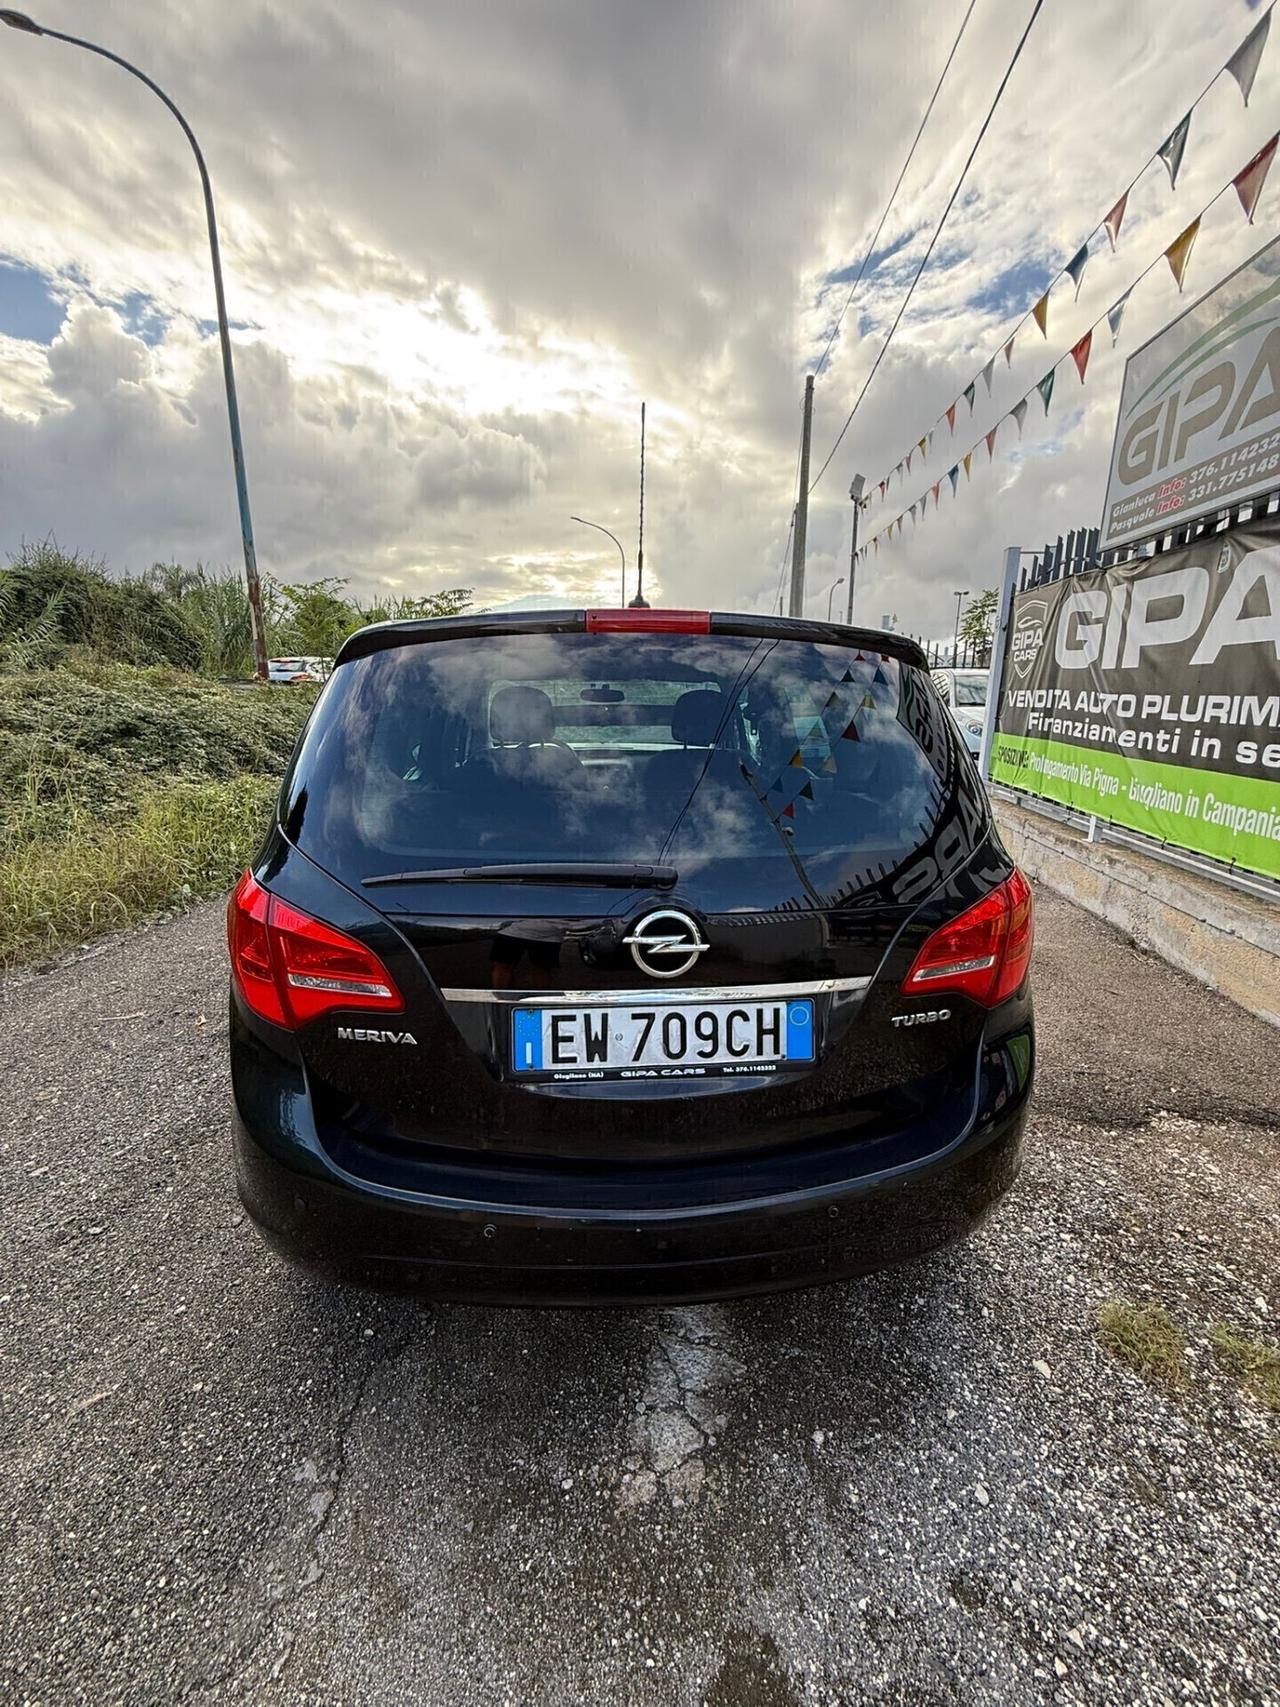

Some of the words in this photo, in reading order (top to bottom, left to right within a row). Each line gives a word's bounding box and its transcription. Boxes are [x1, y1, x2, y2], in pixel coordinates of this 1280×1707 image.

[1113, 492, 1156, 517] Gianluca
[1109, 507, 1155, 533] Pasquale
[1055, 547, 1280, 670] GIPA
[1012, 628, 1044, 651] GIPA
[1014, 649, 1037, 662] CARS
[1008, 689, 1071, 710] VENDITA
[1074, 691, 1137, 718] AUTO
[1141, 694, 1280, 728] PLURIM
[1190, 729, 1221, 759] in
[1079, 763, 1092, 787] Via
[1092, 767, 1119, 797] Pigna
[1185, 789, 1200, 818] in
[891, 1009, 952, 1028] TURBO
[337, 1027, 418, 1045] MERIVA
[551, 1012, 608, 1064] EW
[631, 1007, 781, 1062] 709CH
[620, 1069, 658, 1078] GIPA
[660, 1067, 706, 1076] CARS
